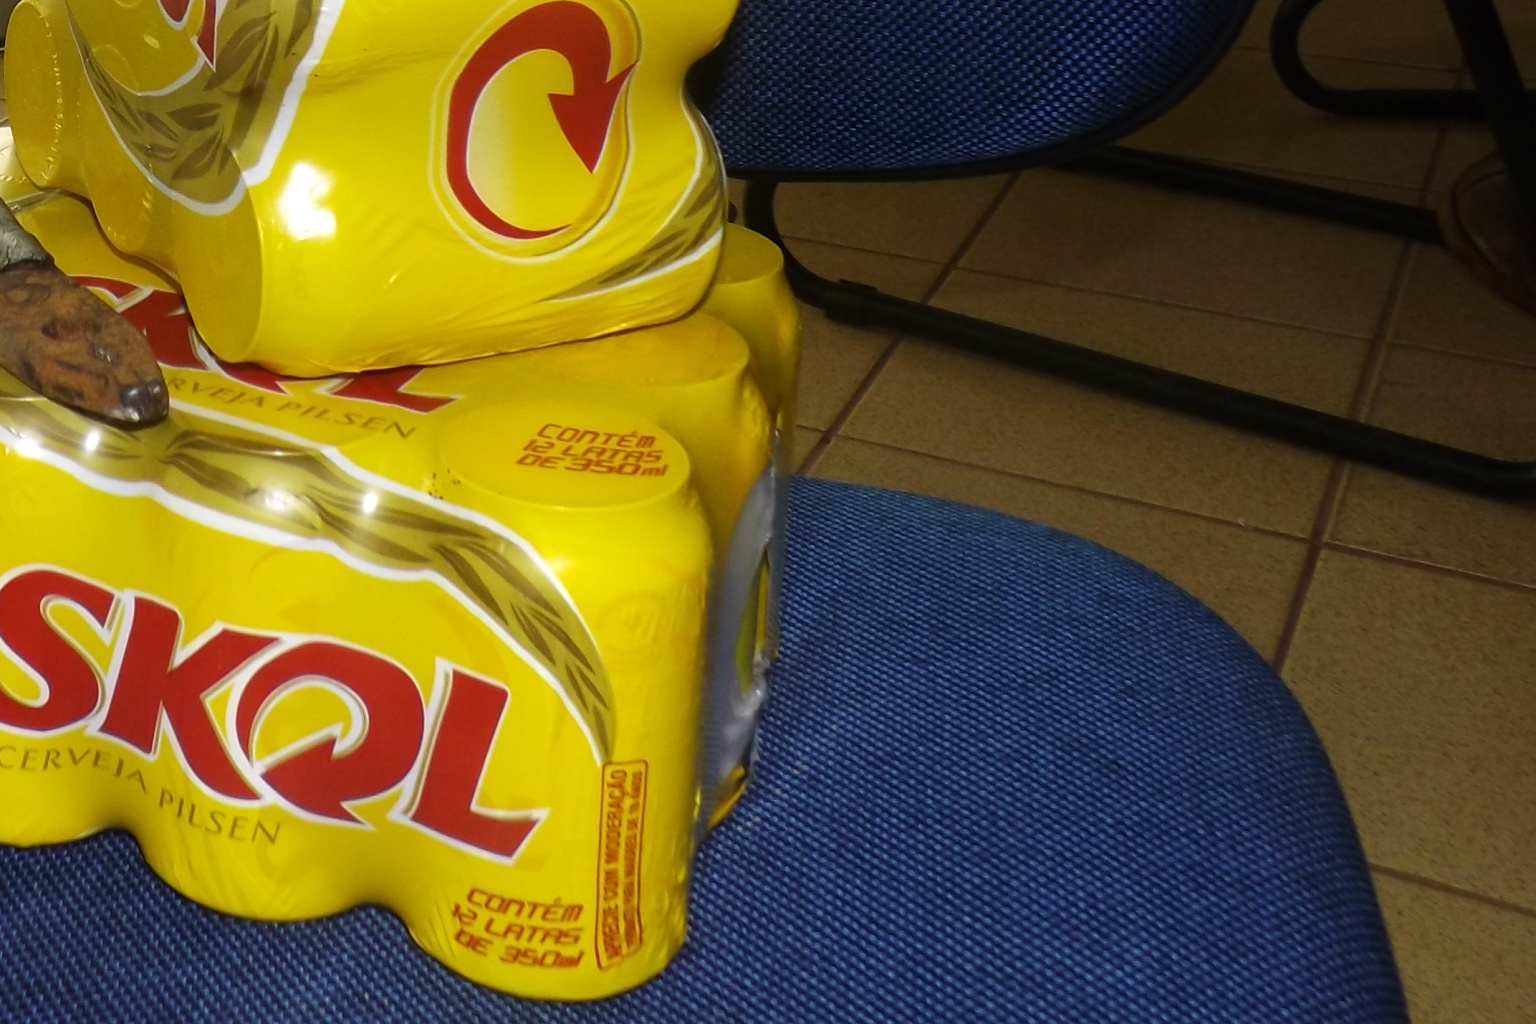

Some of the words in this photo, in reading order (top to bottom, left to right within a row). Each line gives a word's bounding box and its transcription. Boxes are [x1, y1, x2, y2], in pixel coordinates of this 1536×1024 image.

[163, 375, 265, 411] RVEJA
[278, 398, 417, 441] PILSEN
[536, 423, 657, 449] CONTÉM
[515, 452, 566, 470] DE
[563, 457, 669, 477] 350ml
[522, 439, 556, 454] 12
[561, 444, 665, 464] LATAS
[157, 787, 283, 846] PILSEN
[604, 768, 630, 864] MODERAÇÃO
[453, 928, 495, 957] DE
[484, 917, 585, 946] LATAS
